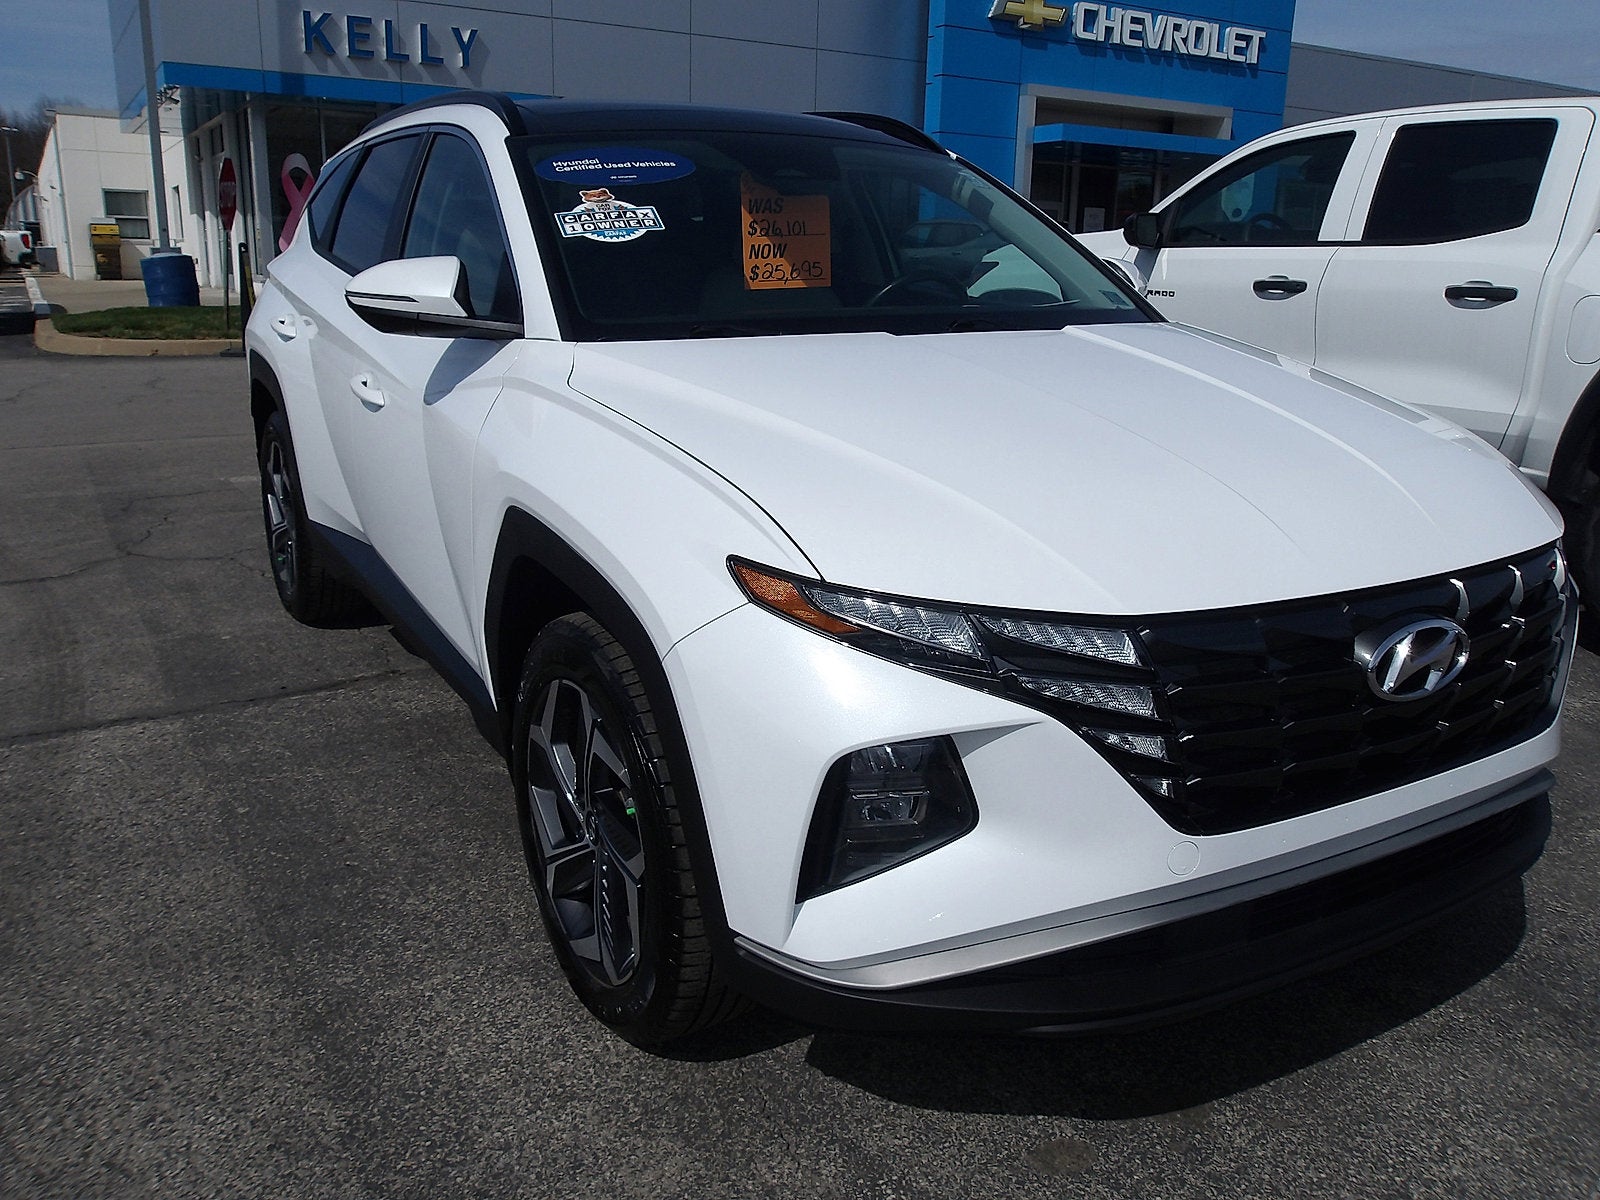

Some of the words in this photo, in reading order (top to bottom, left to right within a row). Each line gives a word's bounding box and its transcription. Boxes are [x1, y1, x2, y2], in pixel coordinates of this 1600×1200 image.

[302, 10, 479, 69] KELLY
[1072, 2, 1267, 64] CHEVROLET
[553, 159, 599, 167] Hyundai
[748, 197, 785, 215] WAS
[564, 211, 651, 223] CARFAX
[583, 219, 655, 229] OWNER
[747, 218, 806, 238] $26,101
[748, 243, 788, 260] NOW
[748, 260, 824, 285] $25,695
